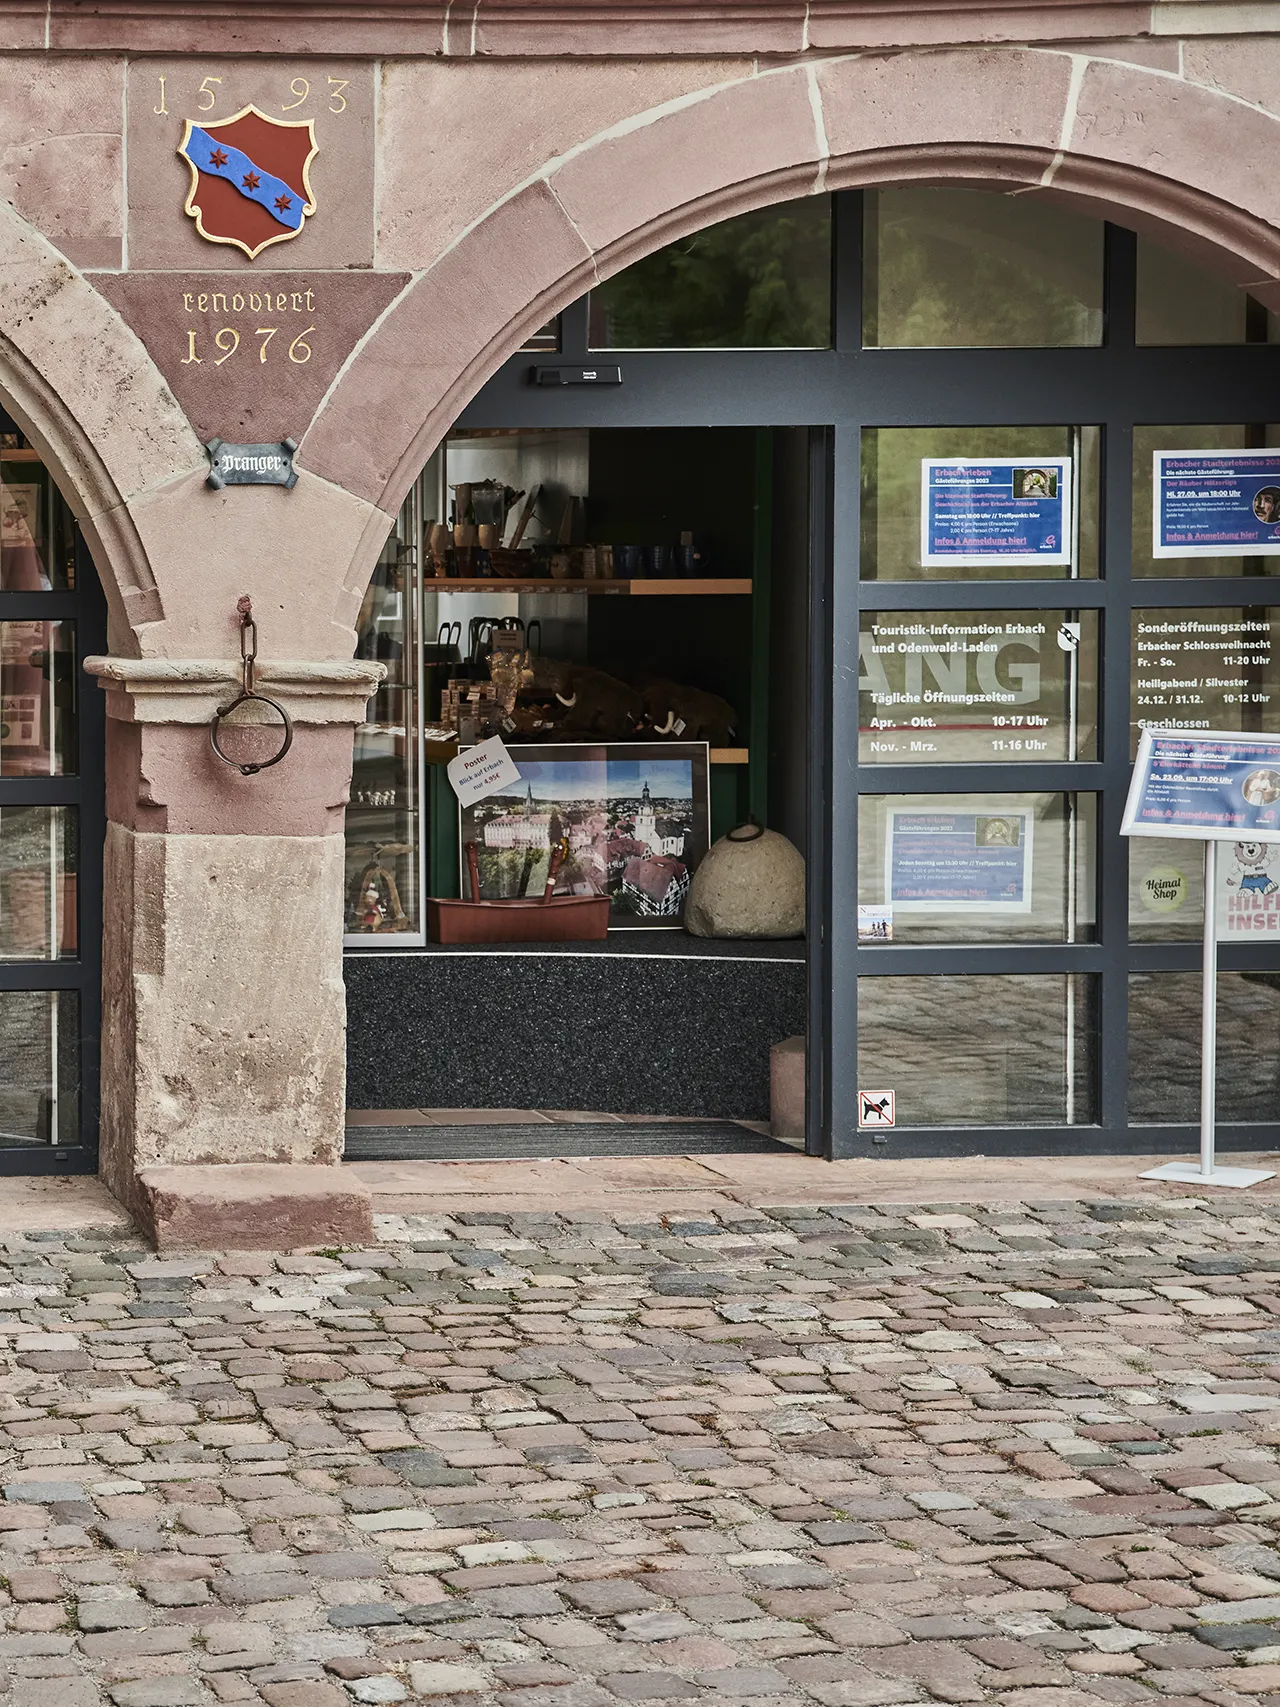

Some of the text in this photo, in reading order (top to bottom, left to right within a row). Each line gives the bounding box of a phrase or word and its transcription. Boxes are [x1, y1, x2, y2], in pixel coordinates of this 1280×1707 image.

[182, 290, 316, 313] renoviert
[180, 325, 316, 366] 1976
[221, 454, 282, 474] Pranger
[1166, 460, 1200, 468] Erbacher
[1202, 459, 1264, 467] Stadterlebnisse
[872, 623, 1046, 636] Touristik-Information Erbach
[1138, 621, 1270, 634] Sonderöffnungszeiten
[872, 641, 998, 653] und Odenwald-Laden
[1138, 640, 1271, 650] Erbacher Schlossweihnacht
[1138, 658, 1151, 666] Fr.
[1160, 658, 1176, 666] So.
[1223, 657, 1249, 665] 11-20
[1252, 656, 1270, 665] Uhr
[1138, 678, 1197, 690] Heiligabend
[1206, 678, 1249, 687] Silvester
[870, 690, 1015, 706] Tägliche Öffnungszeiten
[1138, 696, 1167, 704] 24.12.
[1176, 695, 1204, 704] 31.12.
[1223, 694, 1249, 703] 10-12
[1252, 694, 1270, 702] Uhr
[870, 717, 896, 729] Apr.
[911, 717, 936, 727] Okt.
[992, 716, 1023, 726] 10-17
[1027, 716, 1048, 726] Uhr
[1138, 718, 1209, 728] Geschlossen
[870, 741, 899, 751] Nov.
[910, 741, 937, 751] Mrz.
[992, 740, 1022, 750] 11-16
[1025, 740, 1047, 750] Uhr
[464, 754, 487, 769] Poster
[459, 759, 504, 786] Blick auf Erbach
[473, 782, 483, 790] nur
[1153, 890, 1176, 900] Shop
[1228, 913, 1280, 931] INSE
